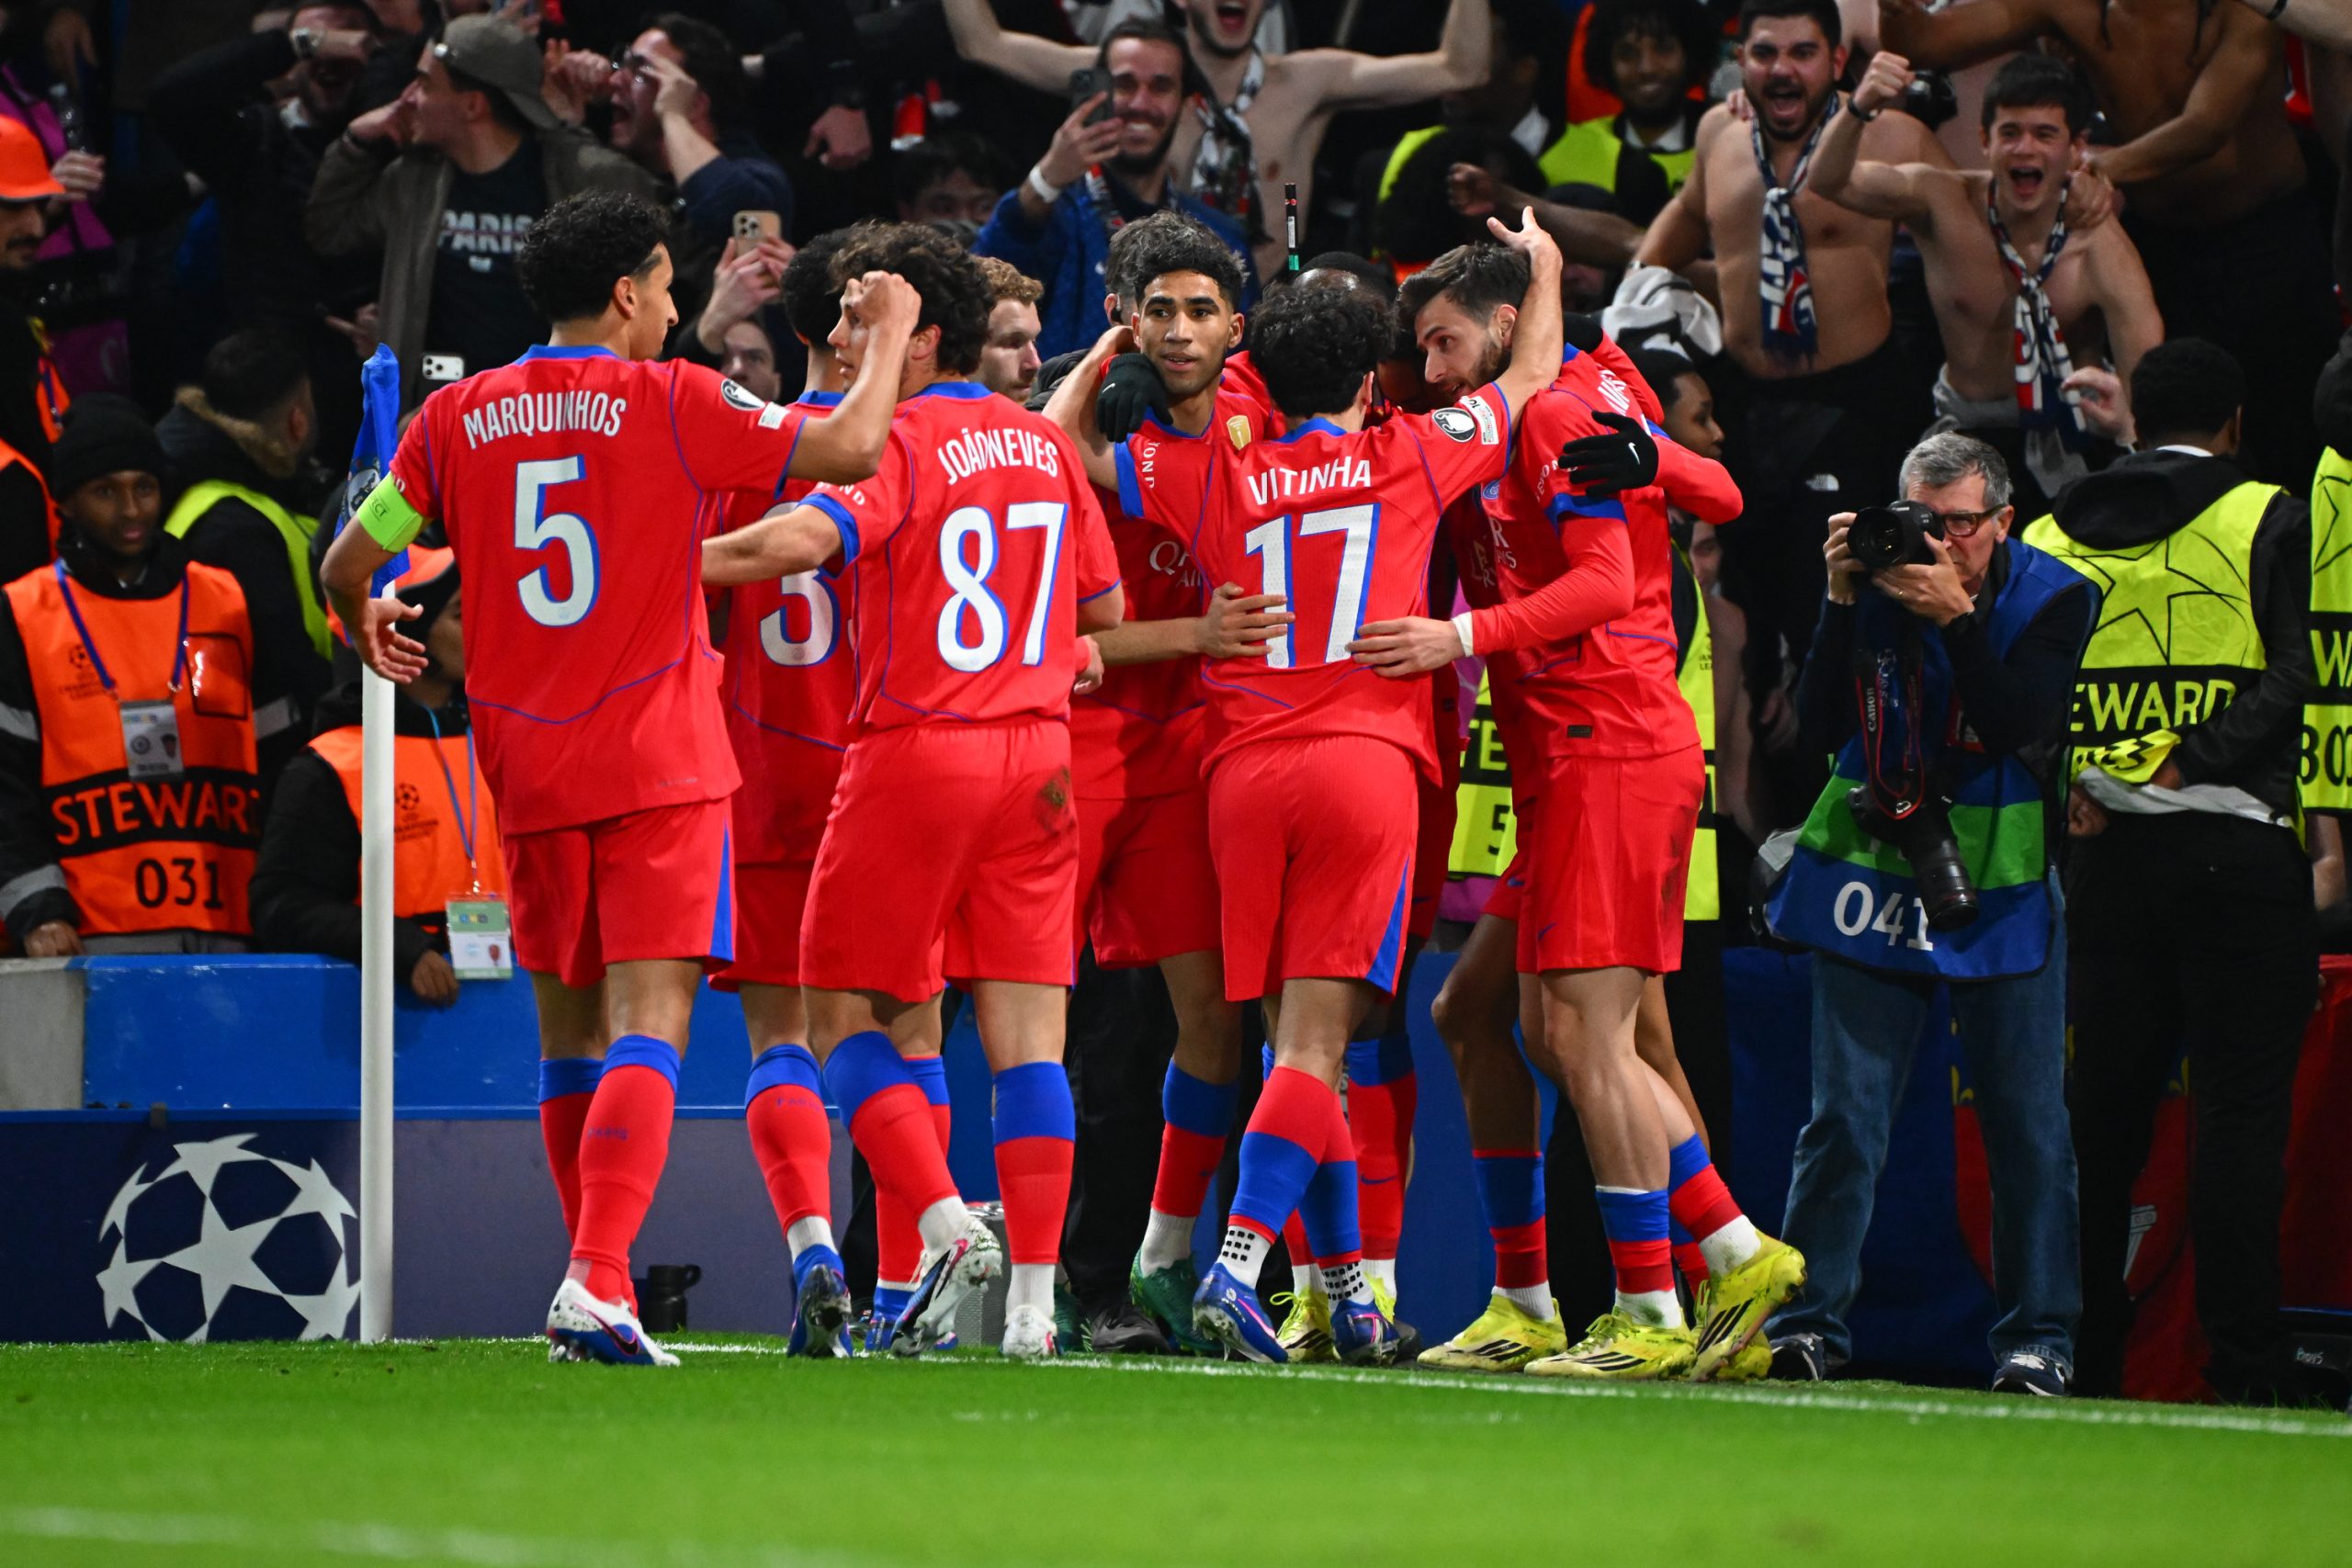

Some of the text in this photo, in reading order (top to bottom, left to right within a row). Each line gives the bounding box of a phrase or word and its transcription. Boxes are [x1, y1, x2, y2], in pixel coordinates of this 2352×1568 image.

[462, 390, 627, 450] MARQUINHOS
[1248, 456, 1372, 505] VITINHA
[514, 454, 601, 628] 5
[760, 501, 856, 666] 3
[937, 501, 1069, 673] 87
[1245, 502, 1381, 669] 17
[1867, 687, 1877, 732] Canon
[51, 782, 260, 845] STEWAR
[135, 858, 223, 908] 031
[1834, 881, 1934, 952] 041
